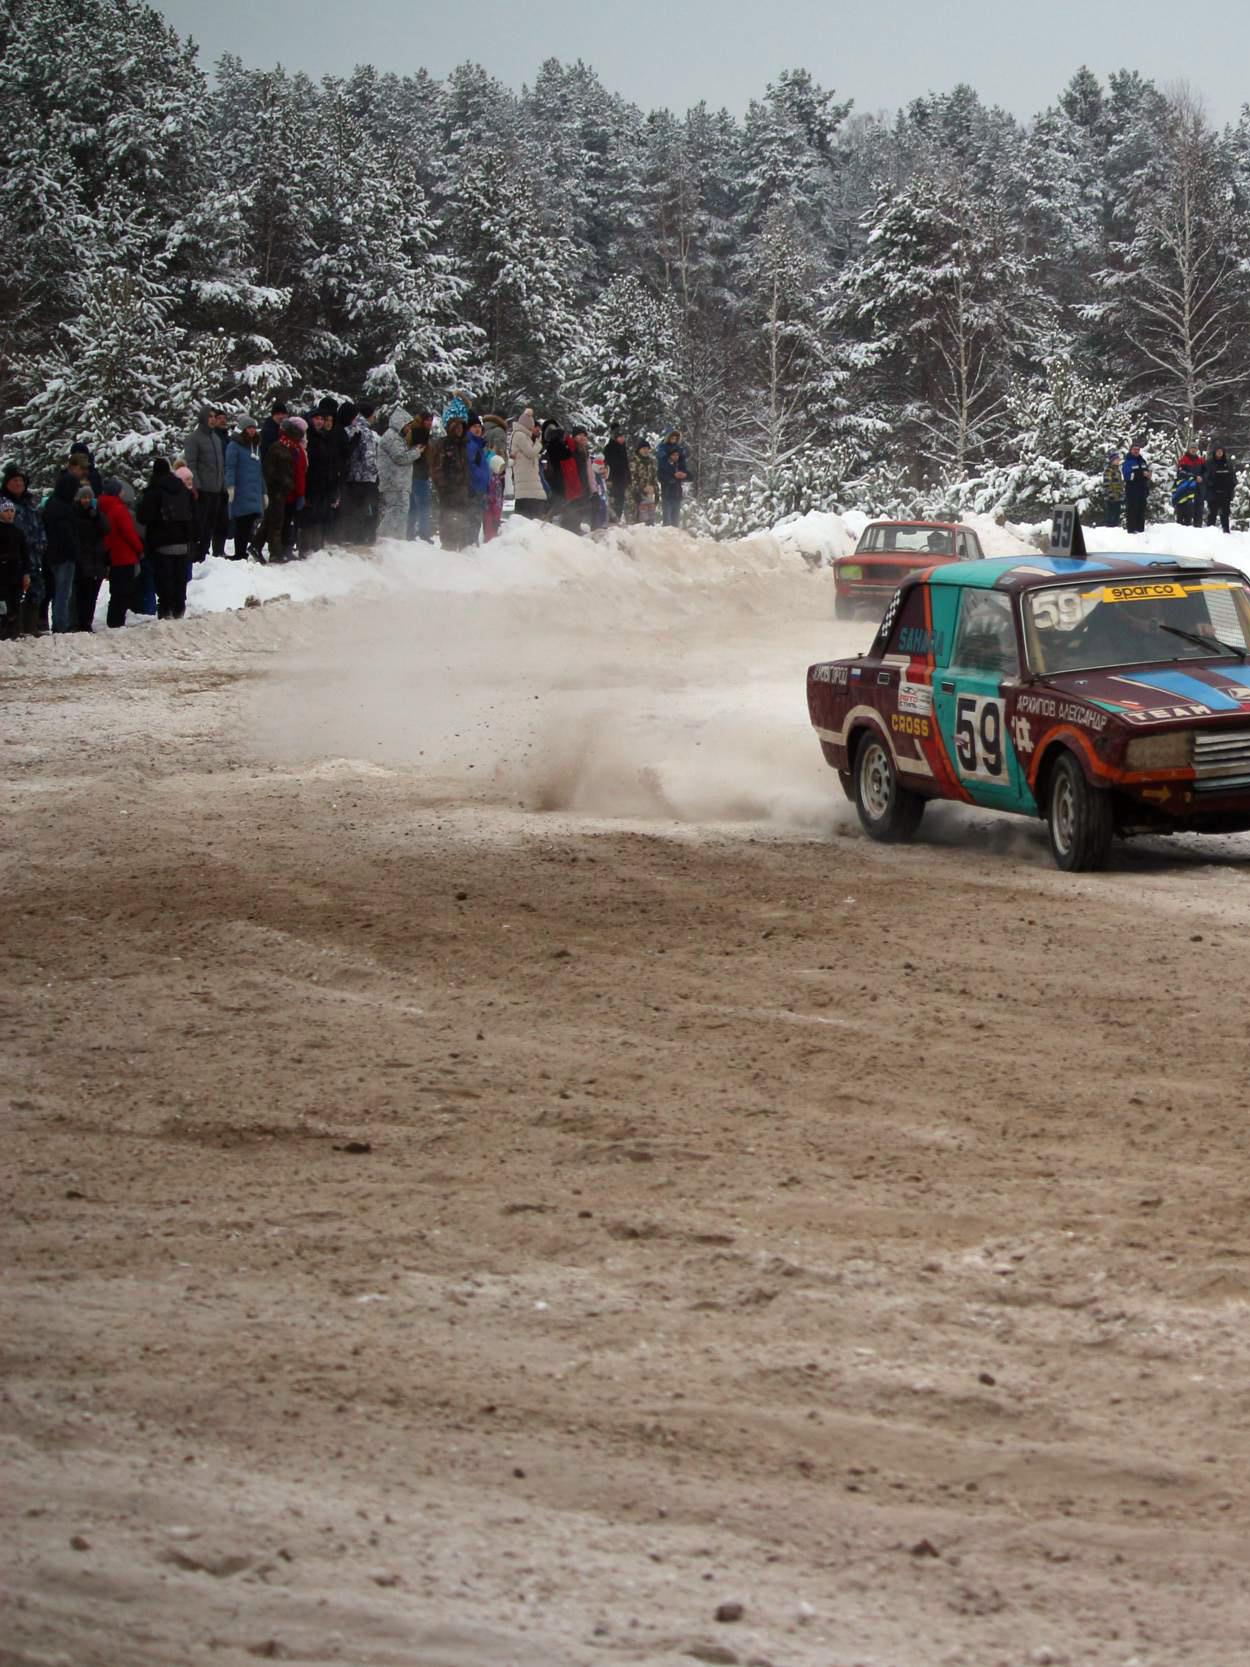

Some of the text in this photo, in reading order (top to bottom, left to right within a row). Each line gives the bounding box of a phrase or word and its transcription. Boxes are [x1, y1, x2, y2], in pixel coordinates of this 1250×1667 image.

[1051, 509, 1075, 549] 59
[1112, 584, 1174, 599] sparco
[1032, 590, 1082, 630] 59
[1016, 695, 1056, 717] АРХИПОВ
[1127, 704, 1212, 720] TEAM
[891, 713, 929, 737] CROSS
[956, 697, 1001, 776] 59
